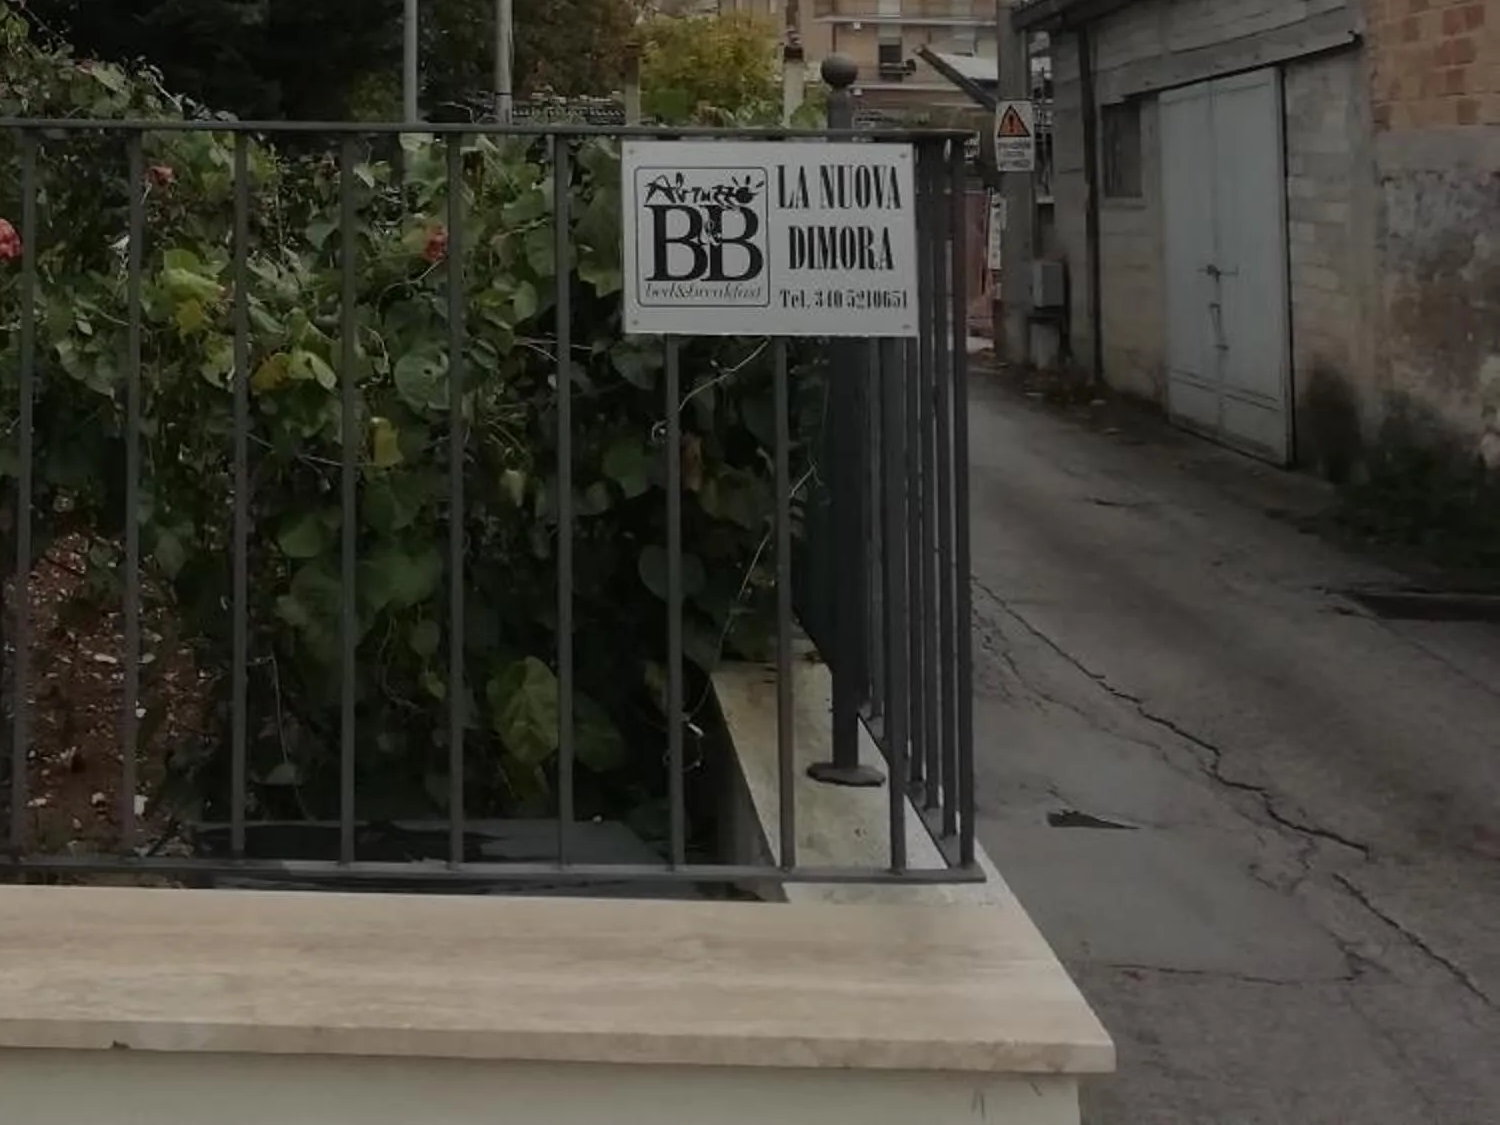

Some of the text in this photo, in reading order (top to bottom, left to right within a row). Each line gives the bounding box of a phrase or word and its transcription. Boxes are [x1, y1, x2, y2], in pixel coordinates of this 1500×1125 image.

[776, 164, 903, 210] LA NUOVA
[788, 226, 894, 270] DIMORA
